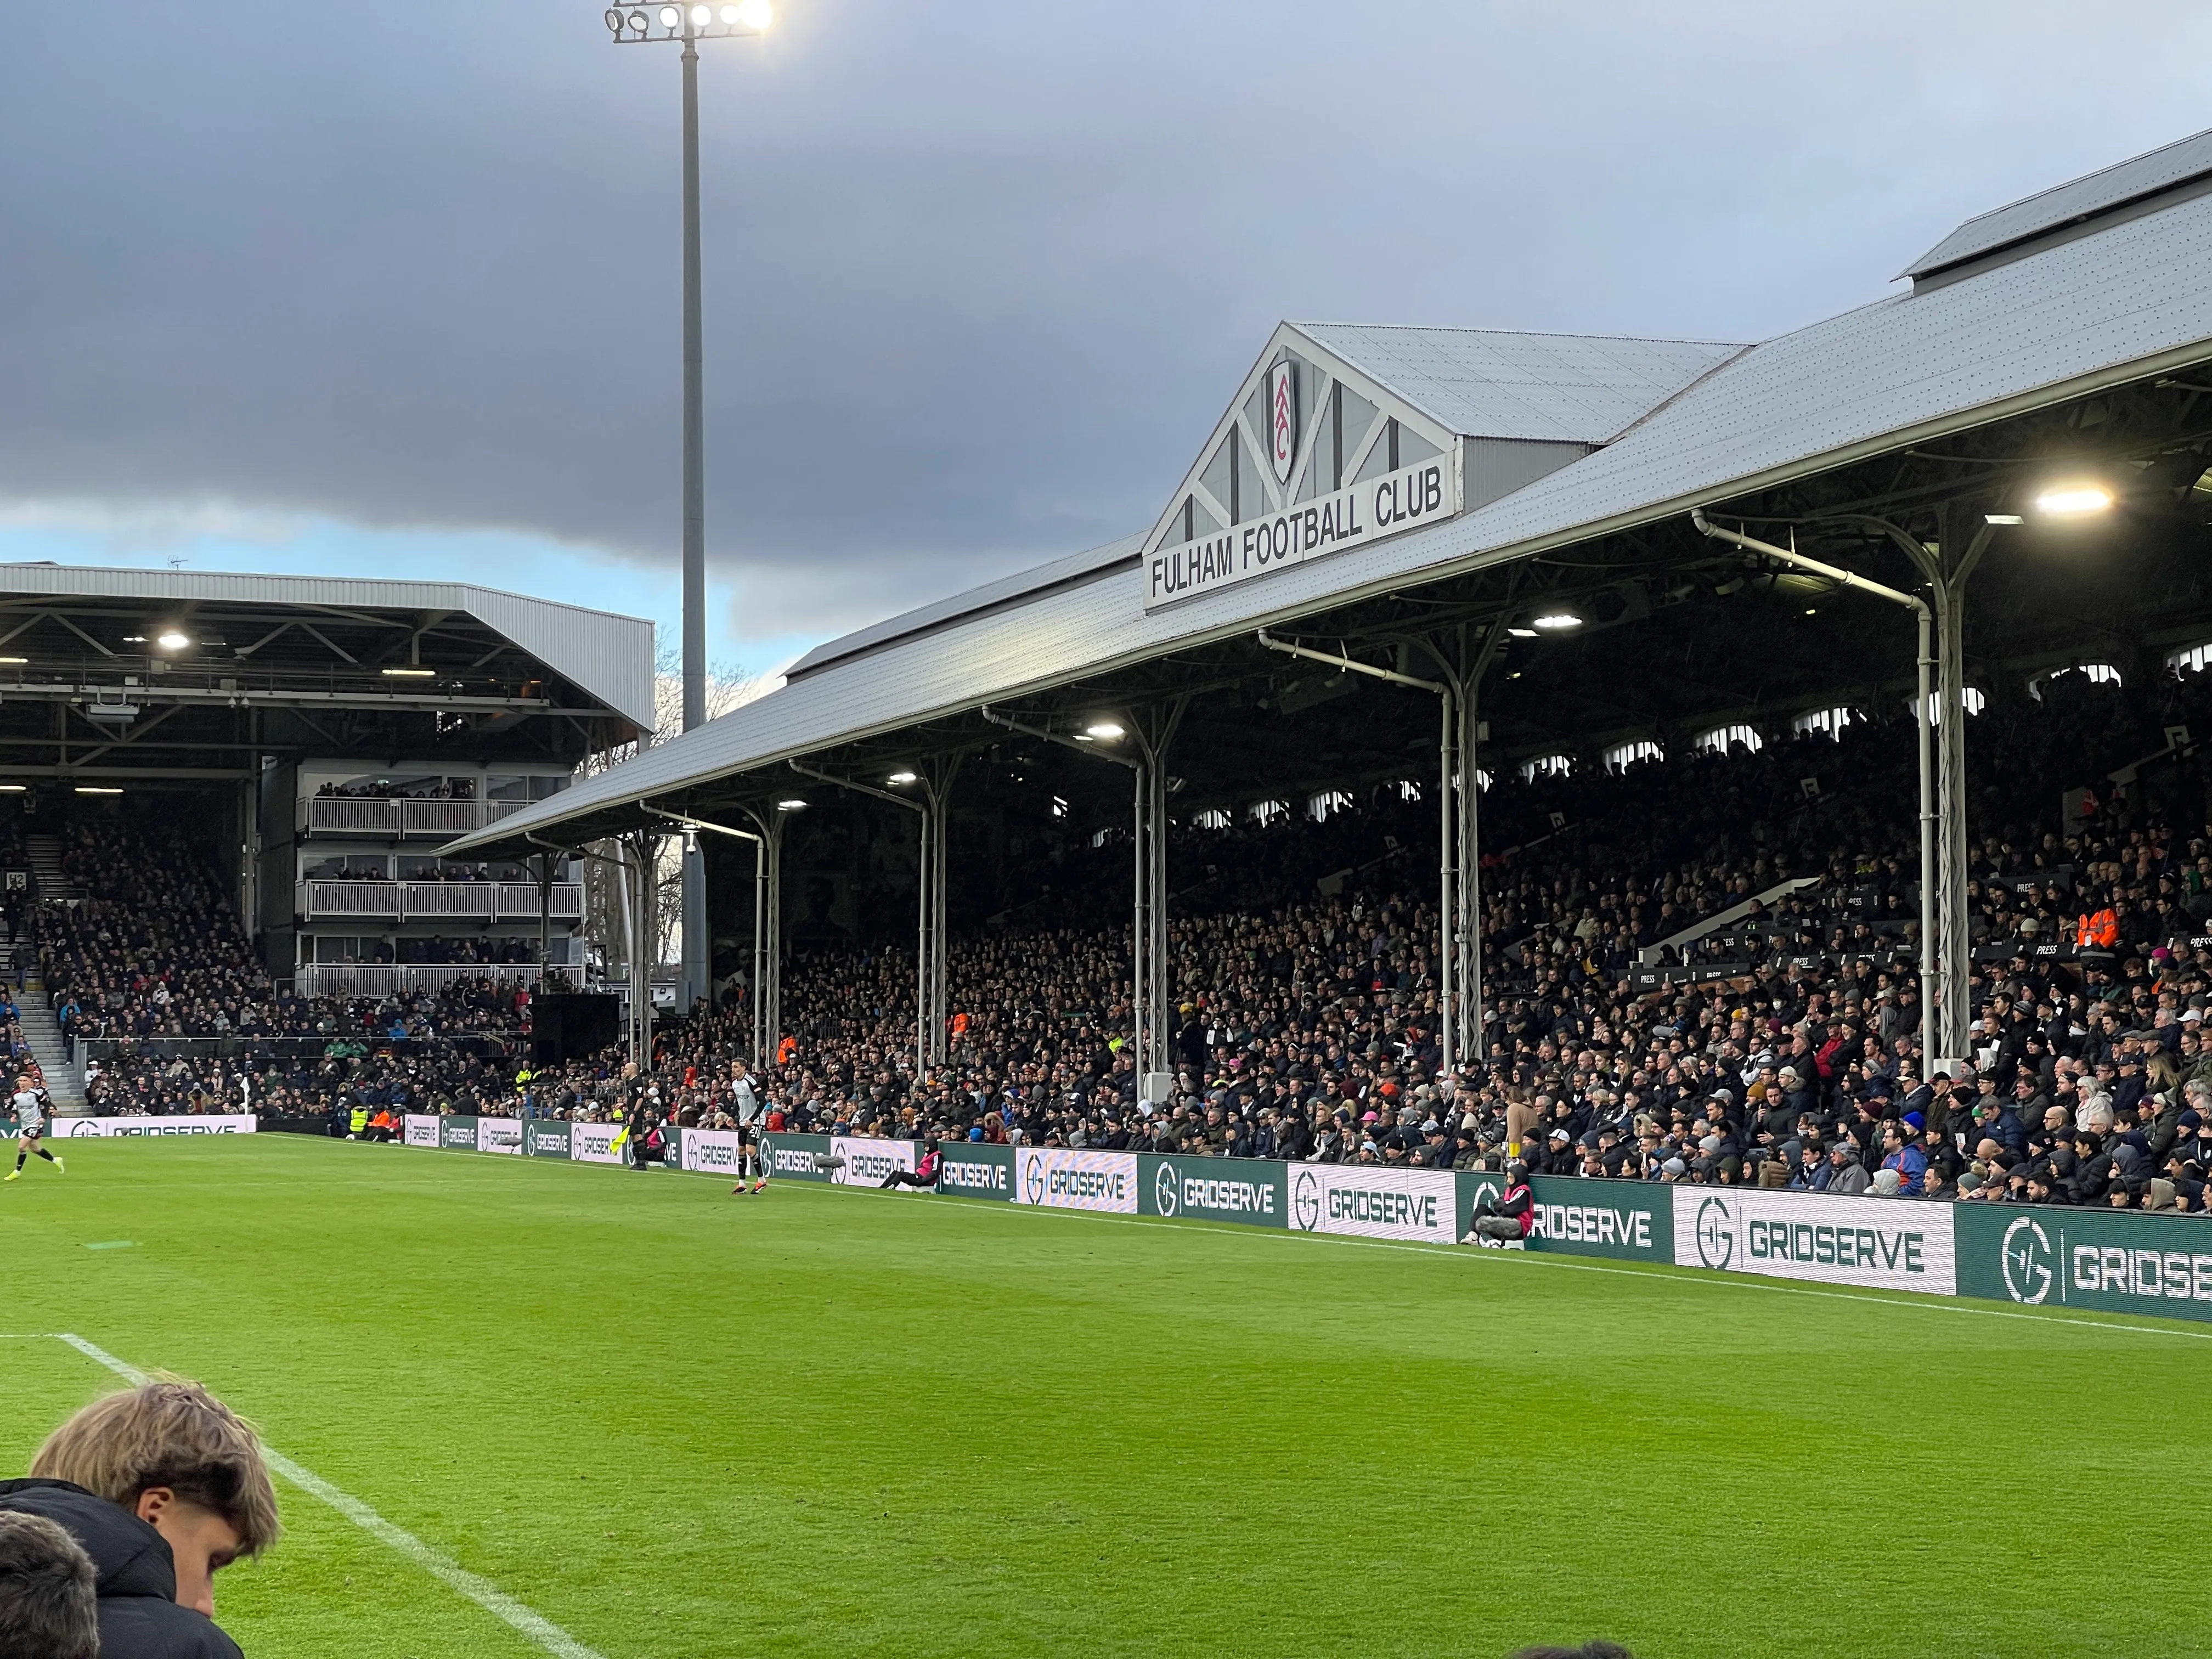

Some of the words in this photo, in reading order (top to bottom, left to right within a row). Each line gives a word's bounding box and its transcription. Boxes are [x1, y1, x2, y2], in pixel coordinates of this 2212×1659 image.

[1152, 535, 1232, 597] FULHAM
[1243, 494, 1363, 570] FOOTBALL
[1375, 466, 1441, 527] CLUB
[2036, 945, 2057, 955] PRESS
[1641, 974, 1655, 984] PRESS
[449, 1127, 475, 1144] GRIDSERVE
[537, 1133, 568, 1152] GRIDSERVE
[749, 1125, 758, 1135] 21
[701, 1144, 738, 1166] GRIDSERV
[943, 1161, 1007, 1190] GRIDSERVE
[1051, 1169, 1125, 1200] GRIDSERVE
[1184, 1178, 1274, 1214] GRIDSERVE
[1329, 1188, 1438, 1228] GRIDSERVE
[1527, 1204, 1652, 1248] RIDSERVE
[1750, 1220, 1926, 1273] GRIDSERVE
